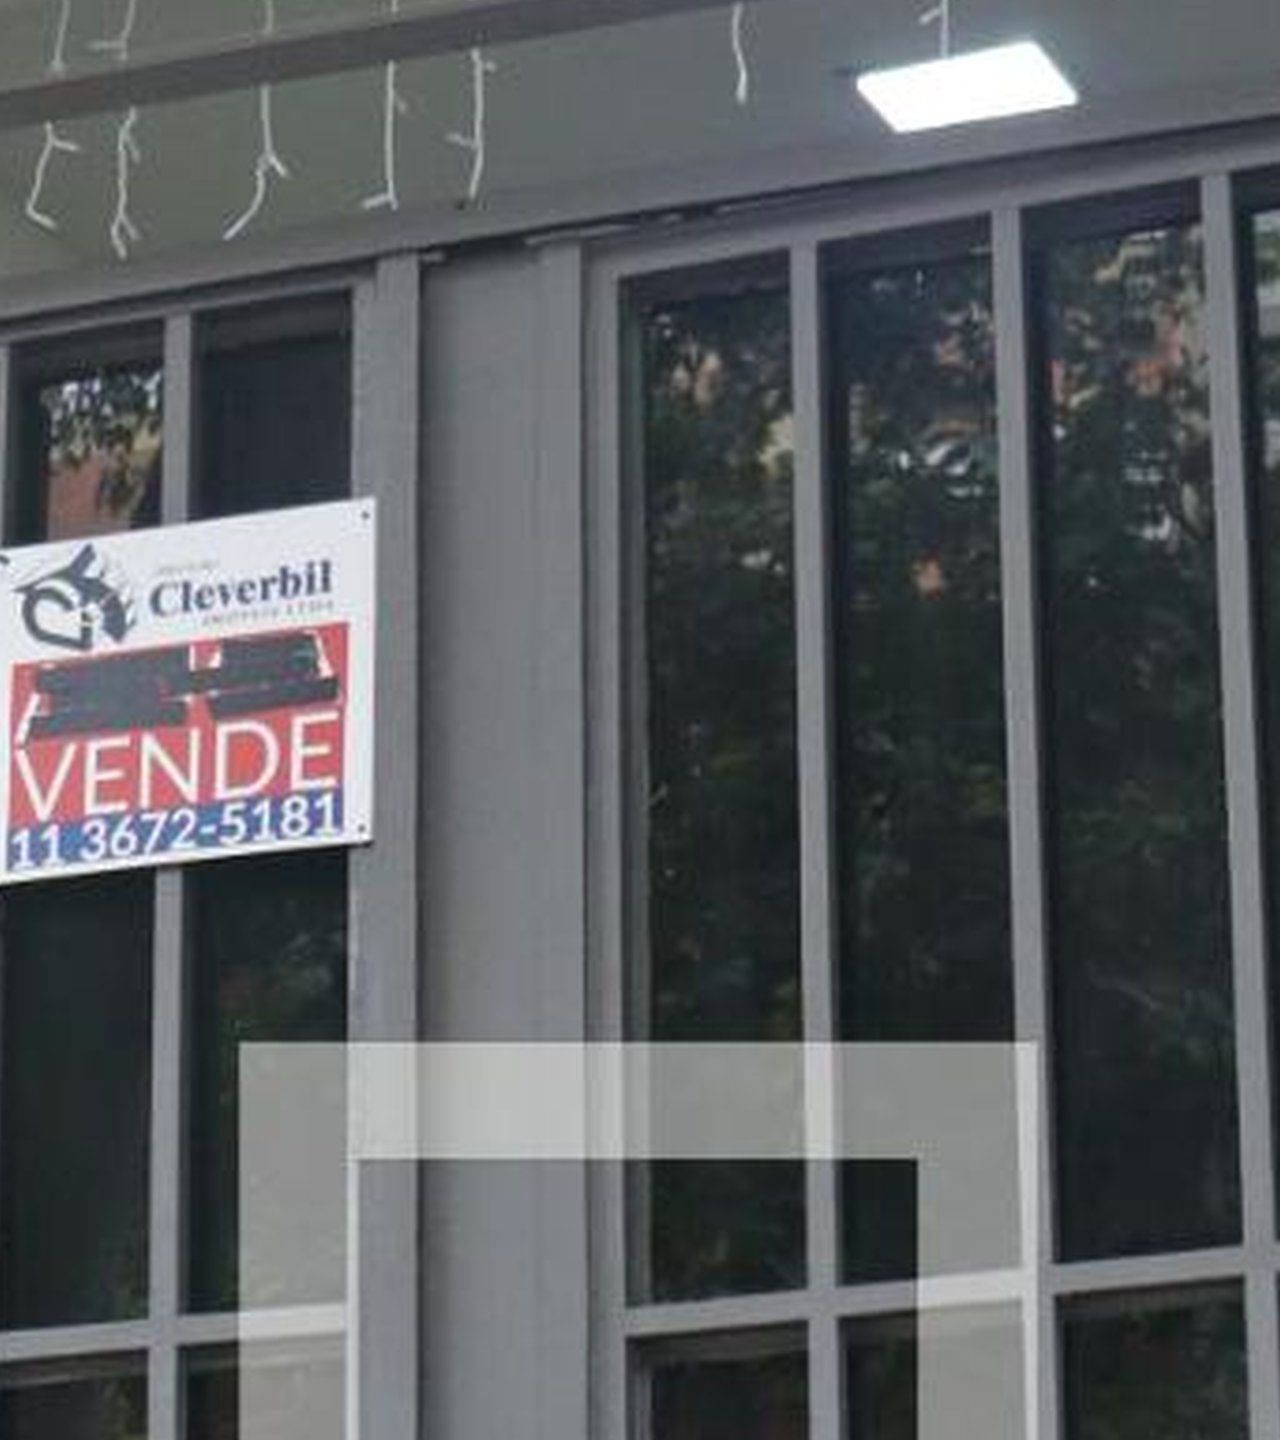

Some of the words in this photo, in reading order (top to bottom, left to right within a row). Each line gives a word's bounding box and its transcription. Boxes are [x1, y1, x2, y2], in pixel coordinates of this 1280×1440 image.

[148, 559, 335, 619] Cleverbil
[13, 711, 341, 823] VENDE
[11, 828, 61, 871] 11
[80, 794, 341, 862] 3672-5181
